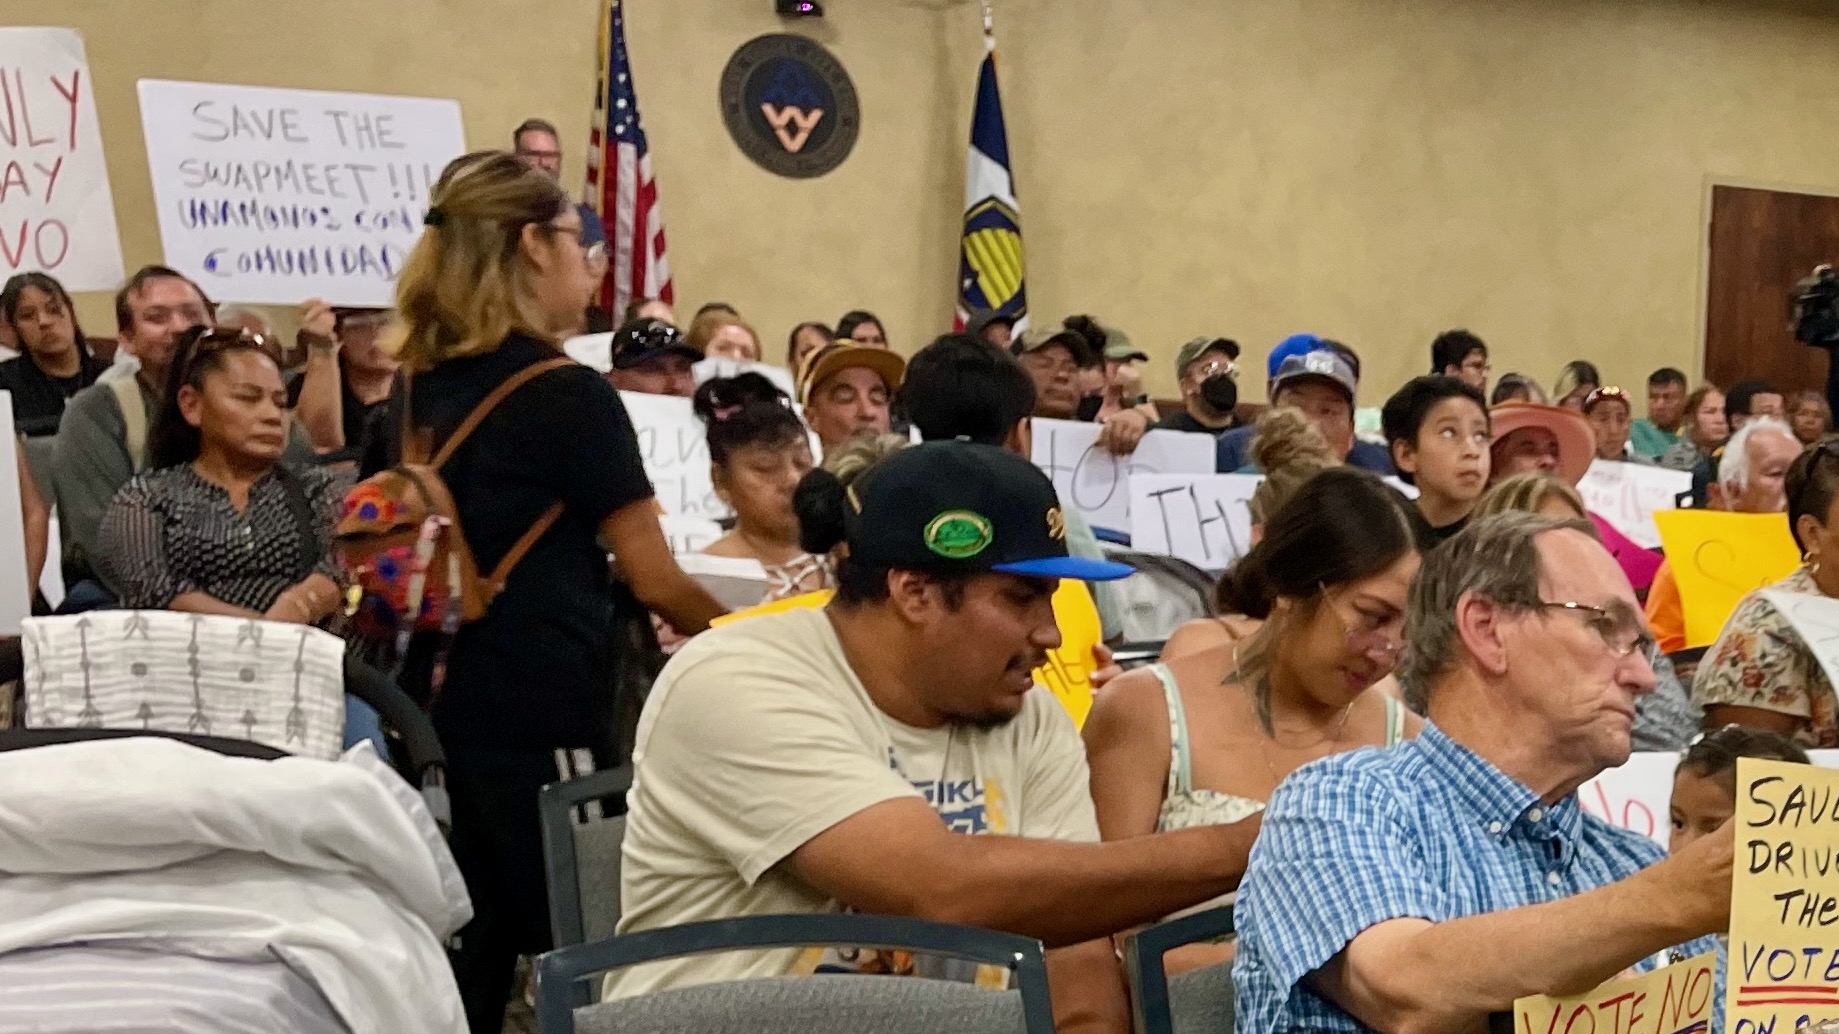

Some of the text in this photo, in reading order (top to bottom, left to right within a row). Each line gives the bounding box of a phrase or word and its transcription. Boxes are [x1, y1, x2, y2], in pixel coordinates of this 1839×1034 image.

[192, 101, 407, 150] SAVE THE
[1147, 483, 1245, 560] TH
